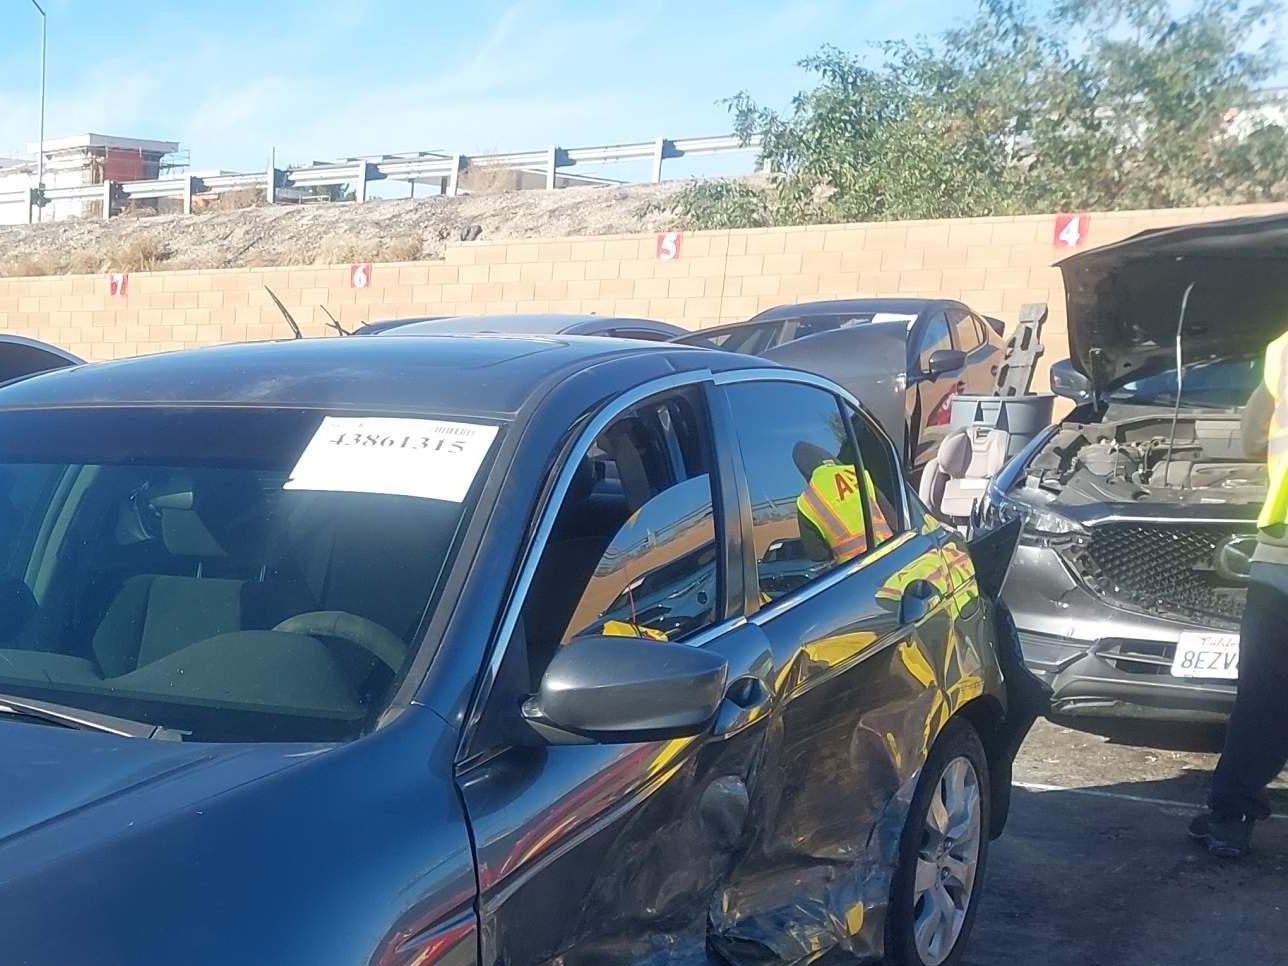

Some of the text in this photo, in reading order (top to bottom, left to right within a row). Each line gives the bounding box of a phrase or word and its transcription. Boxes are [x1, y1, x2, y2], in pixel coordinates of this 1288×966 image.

[1059, 214, 1081, 247] 4
[660, 230, 678, 260] 5
[112, 271, 124, 297] 7
[354, 263, 368, 289] 6
[329, 432, 468, 454] 43861315
[1180, 649, 1238, 670] 8EZV
